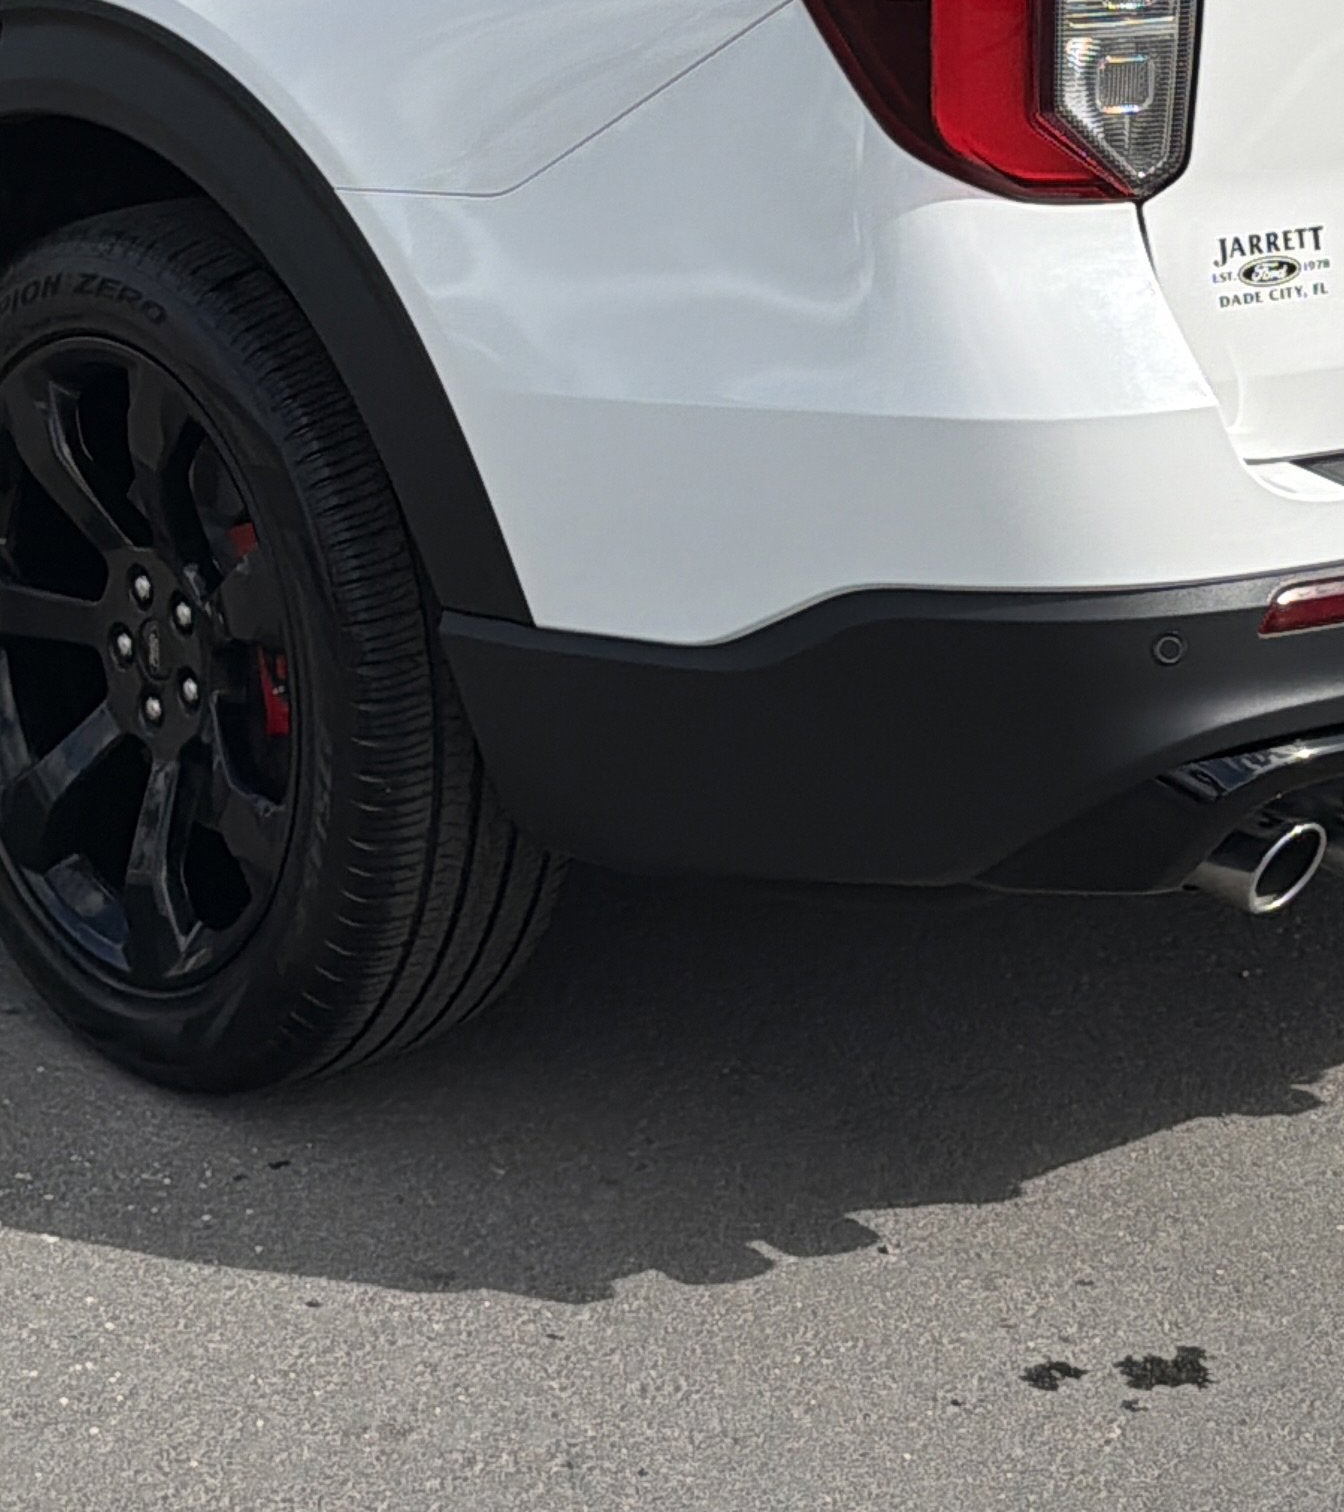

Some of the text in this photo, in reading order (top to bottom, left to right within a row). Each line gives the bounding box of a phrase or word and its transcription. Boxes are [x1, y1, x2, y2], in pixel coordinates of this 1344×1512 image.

[1213, 226, 1323, 268] JARRETT
[72, 272, 167, 324] ZERO
[1219, 291, 1263, 308] DADE
[1313, 282, 1329, 296] FL
